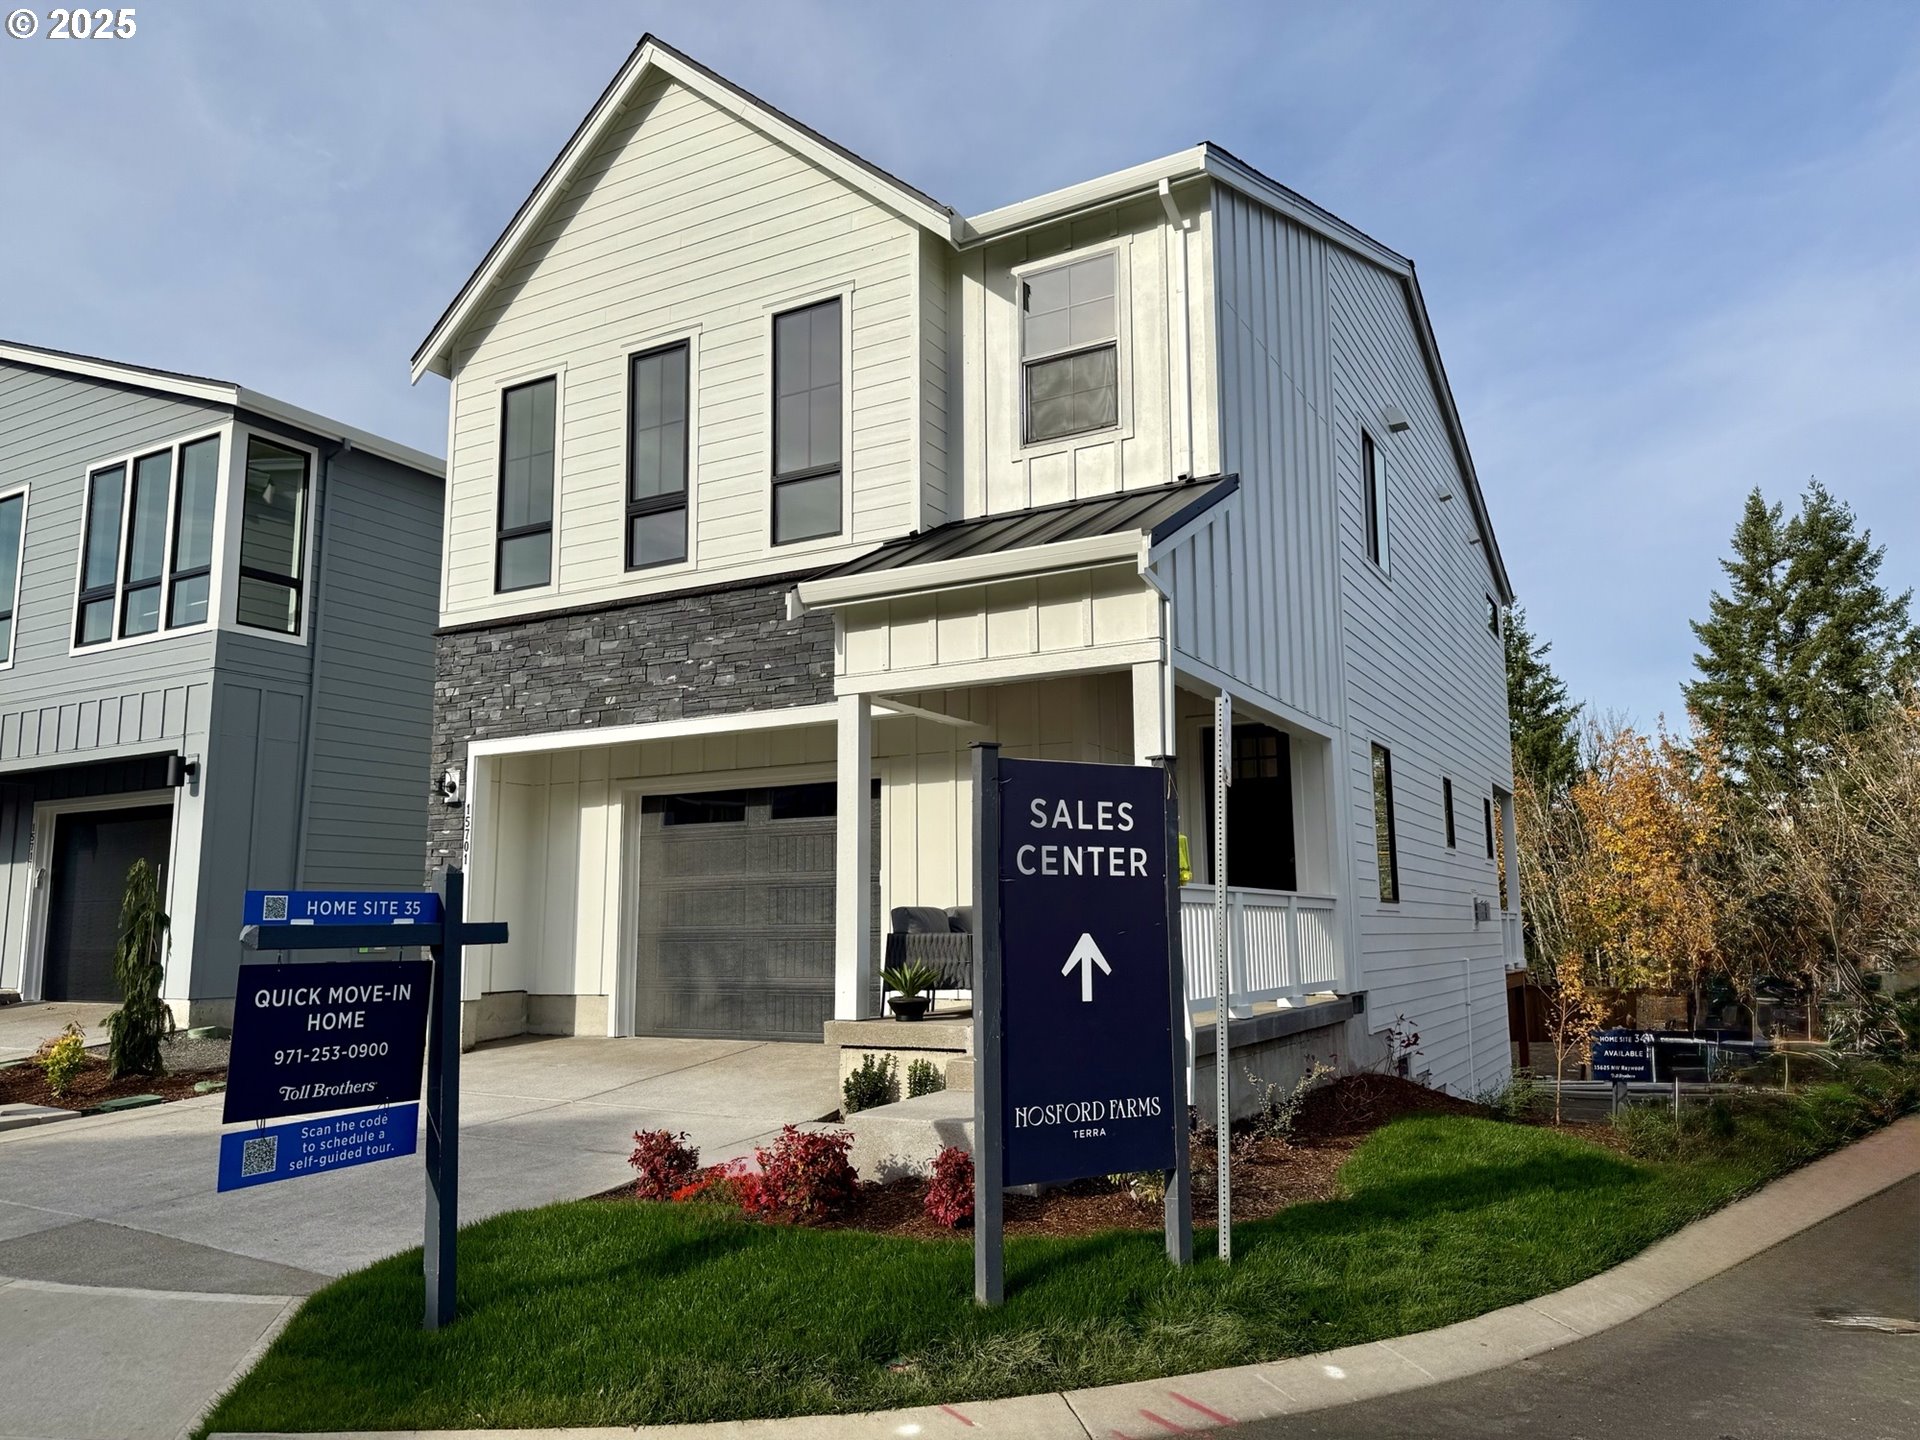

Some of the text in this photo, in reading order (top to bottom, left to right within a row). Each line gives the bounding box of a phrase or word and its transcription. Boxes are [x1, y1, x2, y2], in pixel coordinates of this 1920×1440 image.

[1029, 798, 1135, 832] SALES
[463, 804, 471, 865] 15701
[1016, 844, 1149, 878] CENTER
[306, 900, 422, 916] HOME SITE 35
[254, 984, 412, 1008] QUICK MOVE-IN
[306, 1011, 366, 1032] HOME
[273, 1042, 389, 1065] 971-253-0900
[1603, 1050, 1644, 1058] AVAILABLE
[278, 1080, 376, 1101] Toll Brothers
[1014, 1096, 1162, 1129] HOSFORD FARMS
[301, 1115, 388, 1139] Scan the code
[1072, 1127, 1107, 1140] TERRA
[302, 1130, 385, 1153] to schedule a
[289, 1142, 395, 1171] self-guided tour.
